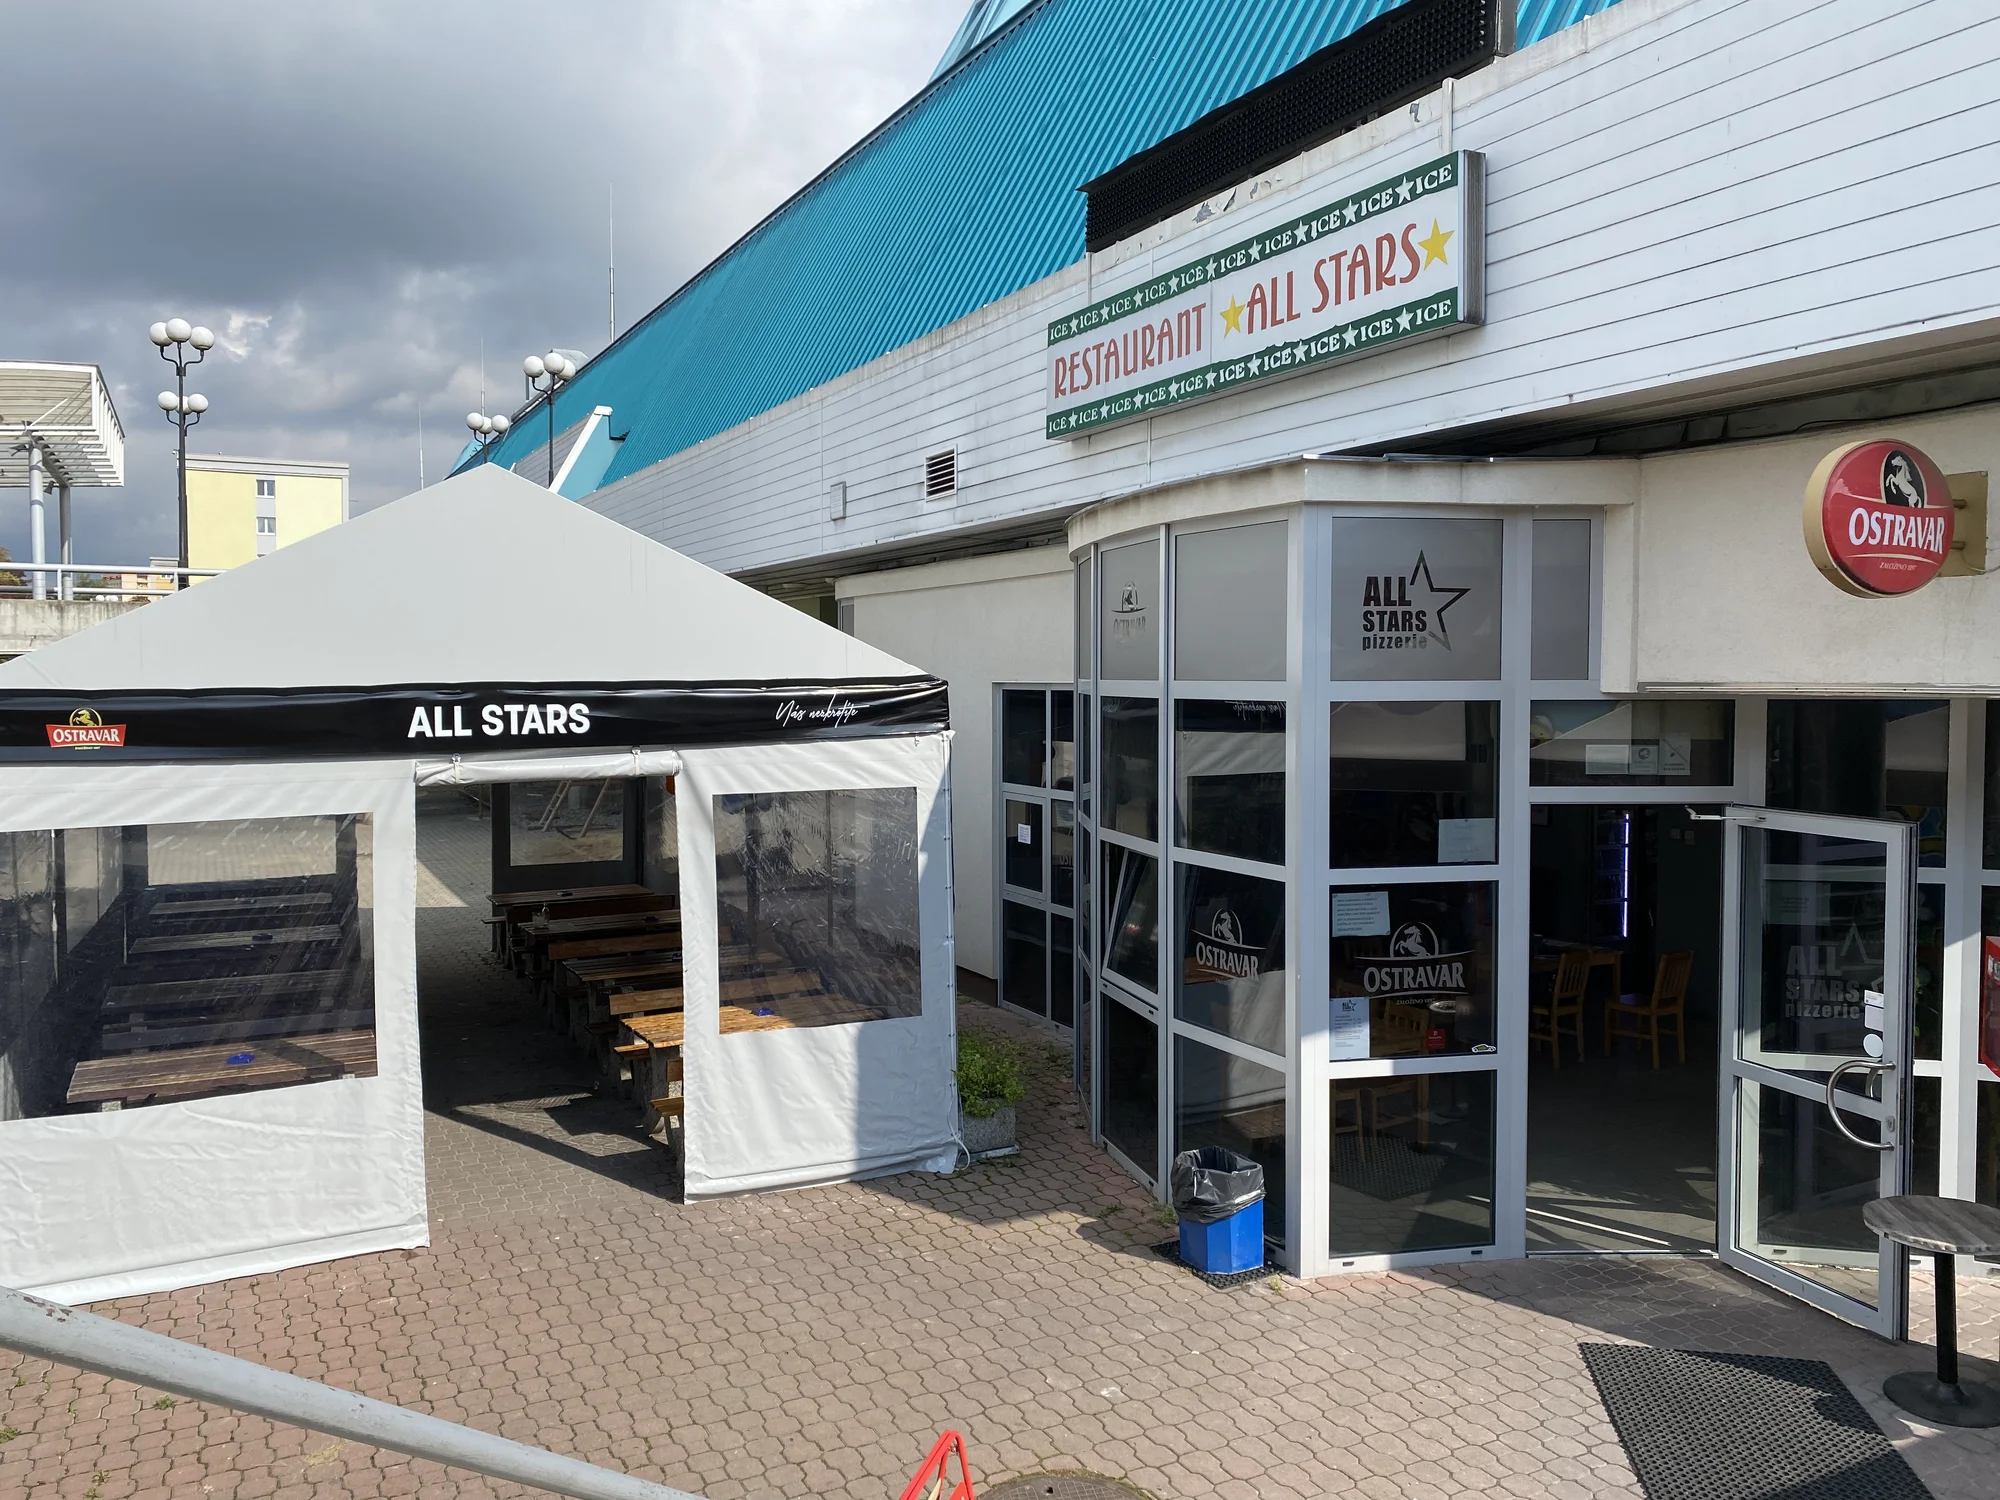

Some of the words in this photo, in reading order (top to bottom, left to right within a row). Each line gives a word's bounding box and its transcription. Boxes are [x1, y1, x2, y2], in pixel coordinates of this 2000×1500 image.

[1050, 323, 1068, 340] ICE
[1079, 310, 1099, 328] ICE
[1111, 297, 1132, 316] ICE
[1145, 282, 1166, 303] ICE
[1181, 265, 1204, 287] ICE
[1220, 250, 1246, 272] ICE
[1264, 230, 1293, 254] ICE
[1311, 209, 1341, 240] ICE
[1360, 188, 1394, 217] ICE
[1415, 163, 1452, 195] ICE
[1055, 302, 1206, 399] RESTAURANT
[1246, 270, 1301, 335] ALL
[1312, 222, 1422, 314] STARS
[1048, 416, 1067, 433] ICE
[1078, 407, 1098, 424] ICE
[1110, 397, 1132, 415] ICE
[1144, 386, 1166, 405] ICE
[1180, 374, 1203, 394] ICE
[1219, 361, 1245, 383] ICE
[1263, 349, 1292, 371] ICE
[1310, 333, 1341, 357] ICE
[1360, 318, 1394, 342] ICE
[1415, 299, 1452, 325] ICE
[1849, 507, 1945, 555] OSTRAVAR
[1363, 576, 1412, 606] ALL
[1362, 610, 1427, 632] STARS
[1362, 634, 1428, 650] pizzerie
[53, 728, 121, 743] OSTRAVAR
[407, 705, 473, 738] ALL
[481, 702, 591, 736] STARS
[1195, 941, 1259, 981] OSTRAVAR
[1786, 945, 1842, 977] ALL
[1363, 962, 1466, 993] OSTRAVAR
[1785, 978, 1860, 1003] STARS
[1785, 1001, 1860, 1019] pizzerie
